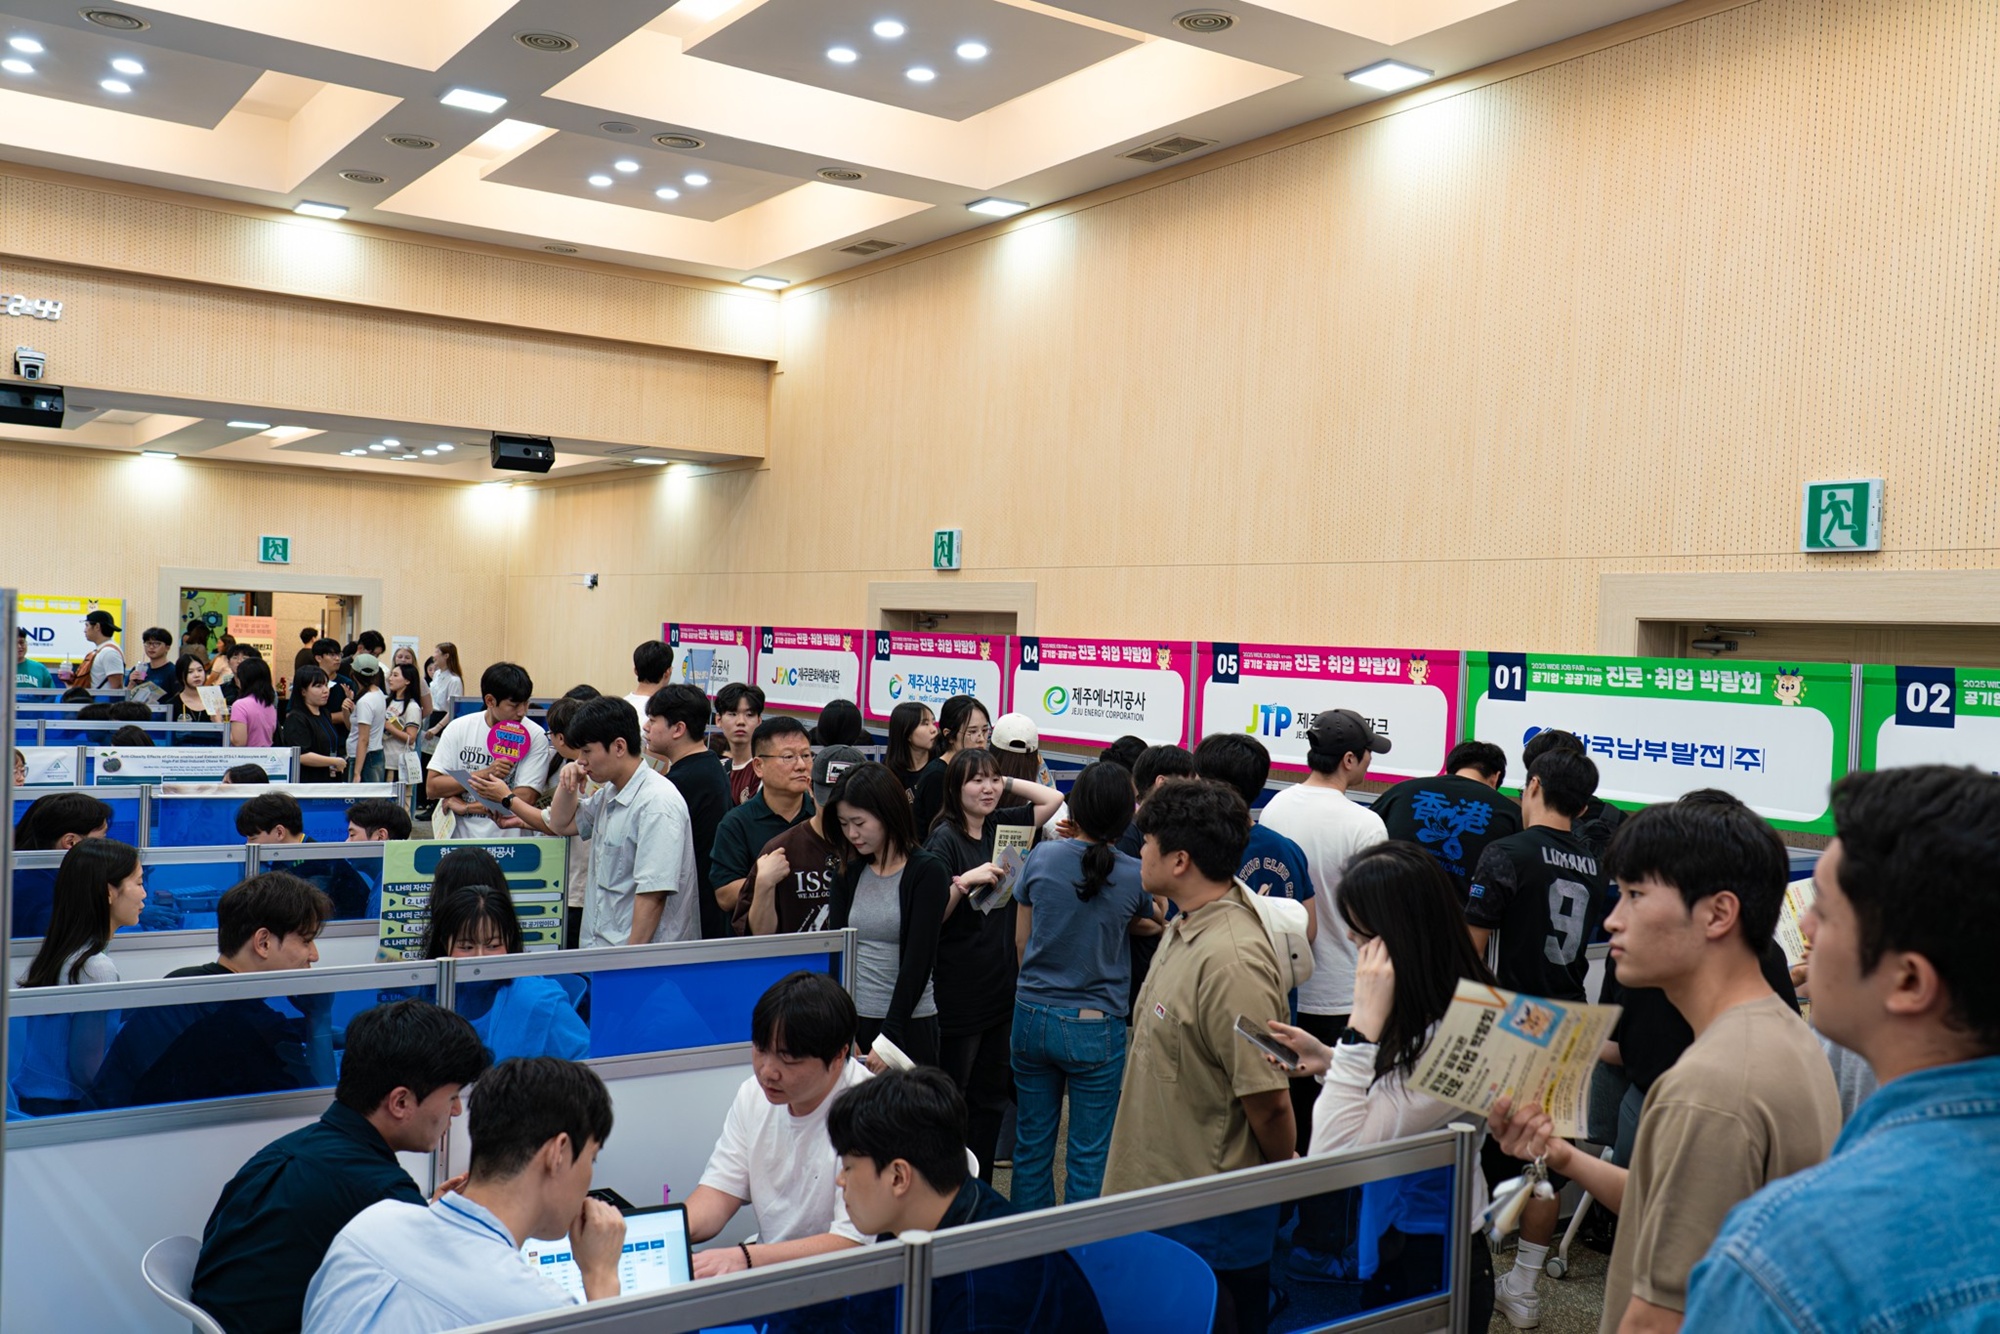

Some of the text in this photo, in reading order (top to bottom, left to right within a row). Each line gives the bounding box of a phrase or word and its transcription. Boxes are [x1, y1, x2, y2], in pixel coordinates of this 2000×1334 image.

[671, 629, 679, 642] 01
[763, 634, 773, 648] 02
[877, 638, 889, 654] 03
[1024, 645, 1038, 663] 04
[1122, 646, 1152, 663] 박람회
[1217, 654, 1238, 675] 05
[1359, 657, 1400, 677] 박람회
[908, 674, 976, 697] 제주신용보증재단
[1494, 665, 1522, 690] 01
[1699, 670, 1762, 695] 박람회
[1963, 680, 1986, 689] 2025
[1072, 687, 1146, 711] 제주에너지공사
[1905, 682, 1951, 714] 02
[1071, 708, 1145, 722] JEJU ENERGY CORPORATION
[1246, 703, 1292, 737] JTP
[496, 730, 525, 745] WIDE
[493, 744, 519, 758] FAIR
[1542, 846, 1597, 876] LUKAKU
[1544, 878, 1591, 966] 9
[1470, 1008, 1496, 1048] 박람회
